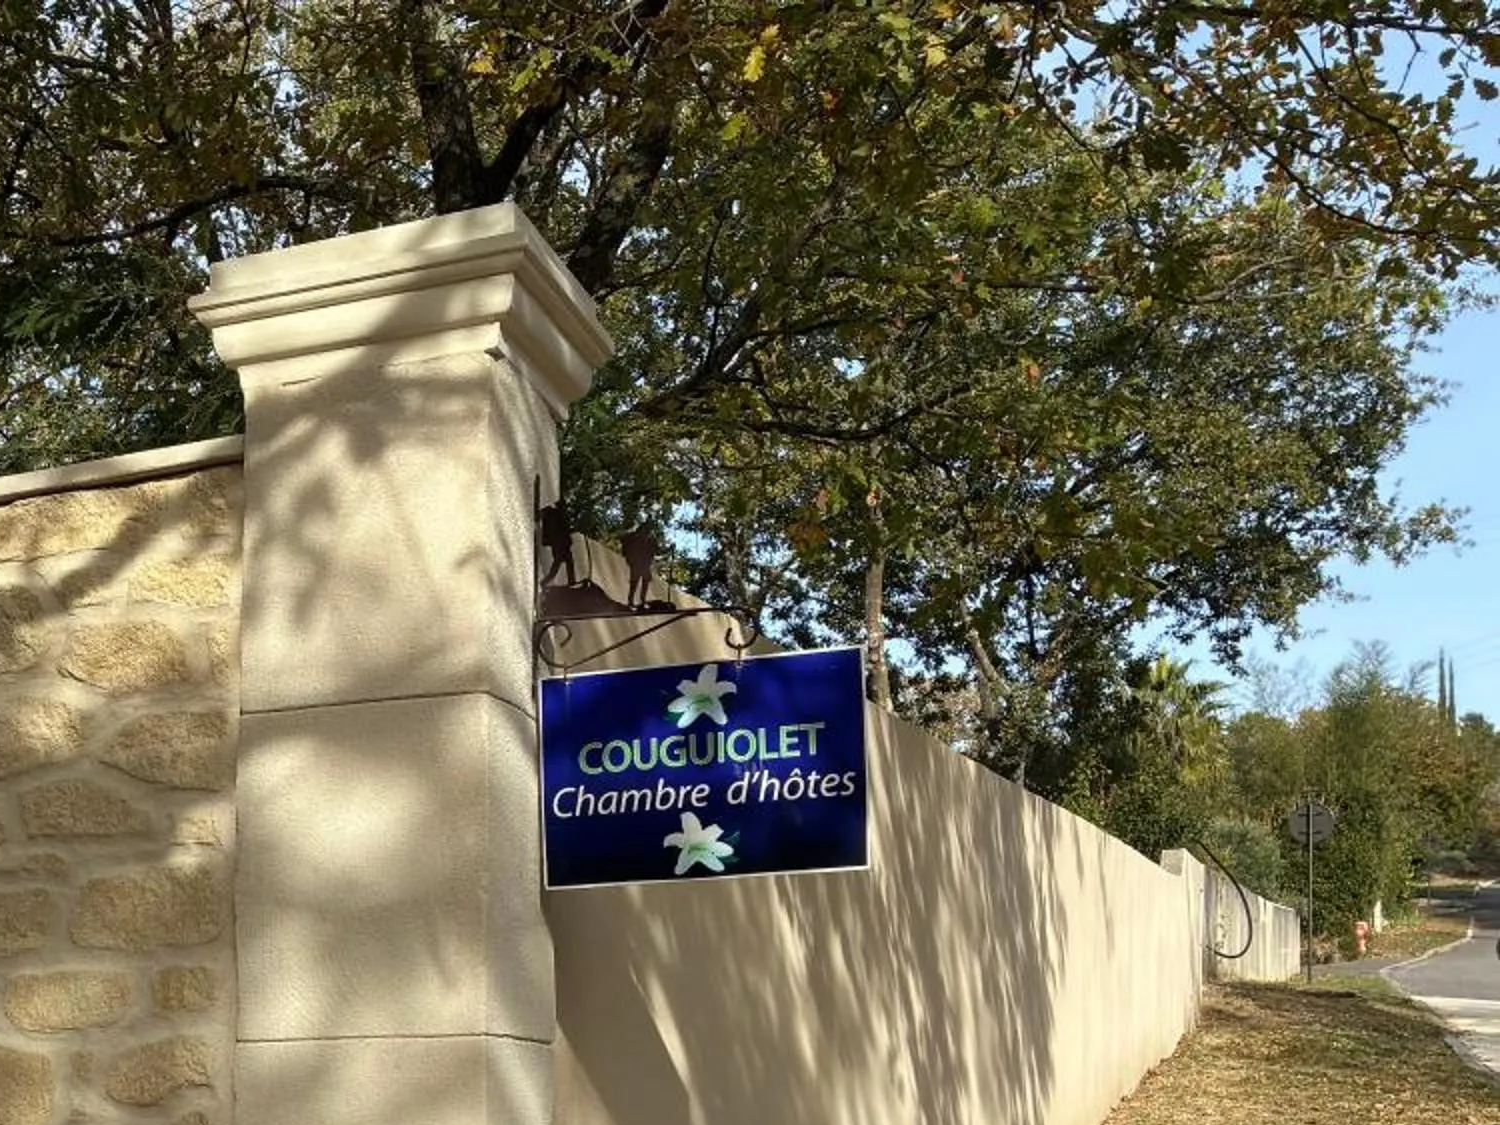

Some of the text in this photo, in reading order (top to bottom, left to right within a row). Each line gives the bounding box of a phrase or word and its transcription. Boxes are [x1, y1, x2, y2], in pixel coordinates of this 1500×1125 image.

[578, 721, 825, 775] COUGUIOLET
[552, 768, 856, 818] Chambre d'hôtes
